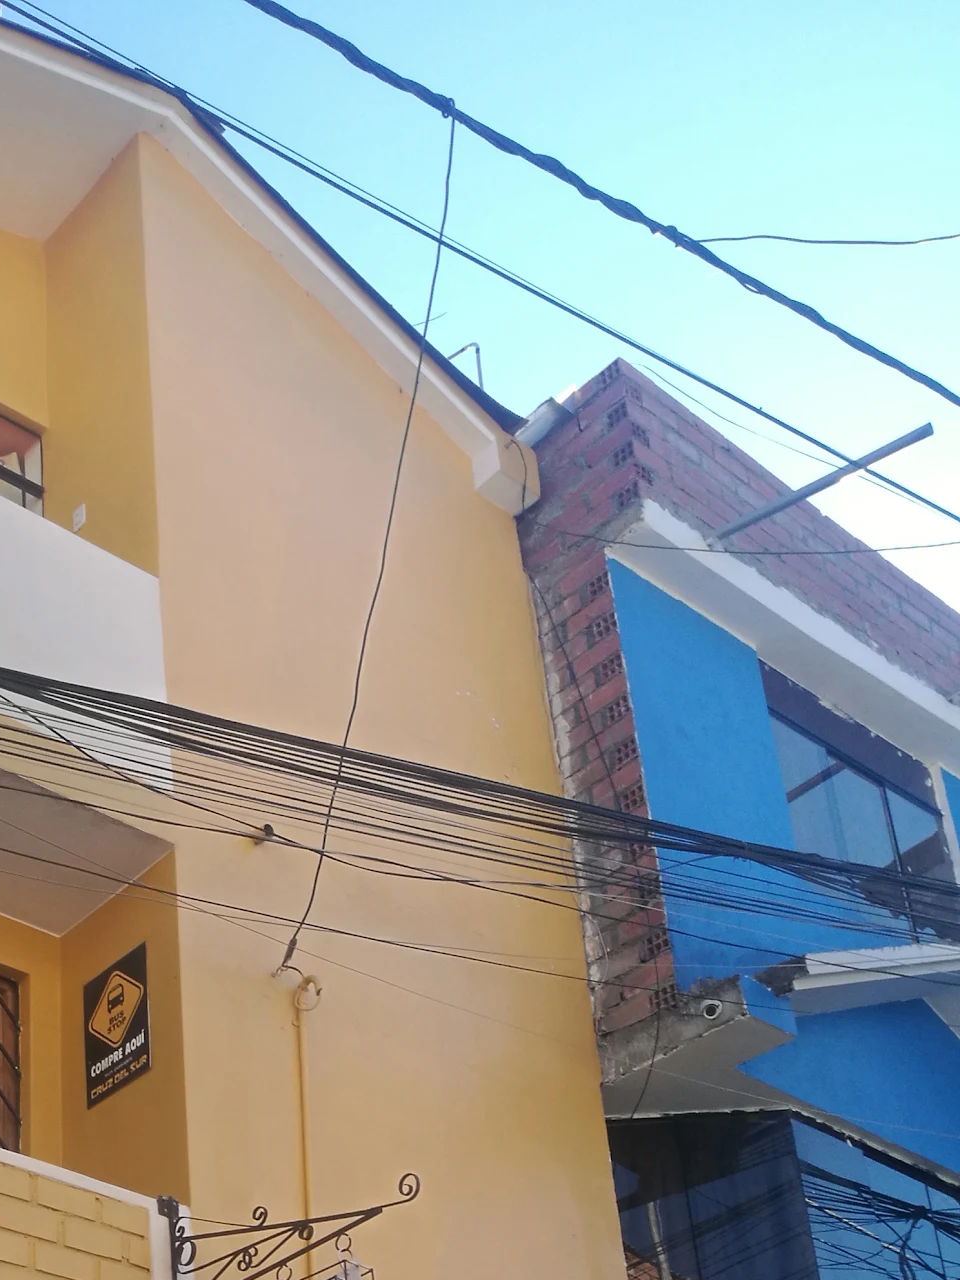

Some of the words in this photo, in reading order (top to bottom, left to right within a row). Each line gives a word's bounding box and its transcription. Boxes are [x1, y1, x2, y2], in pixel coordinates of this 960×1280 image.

[107, 1016, 126, 1034] STOP
[109, 1009, 124, 1025] BUS
[91, 1047, 123, 1077] COMPRE
[91, 1077, 113, 1099] CRUZ
[114, 1069, 129, 1083] DEL
[130, 1054, 147, 1073] SUR
